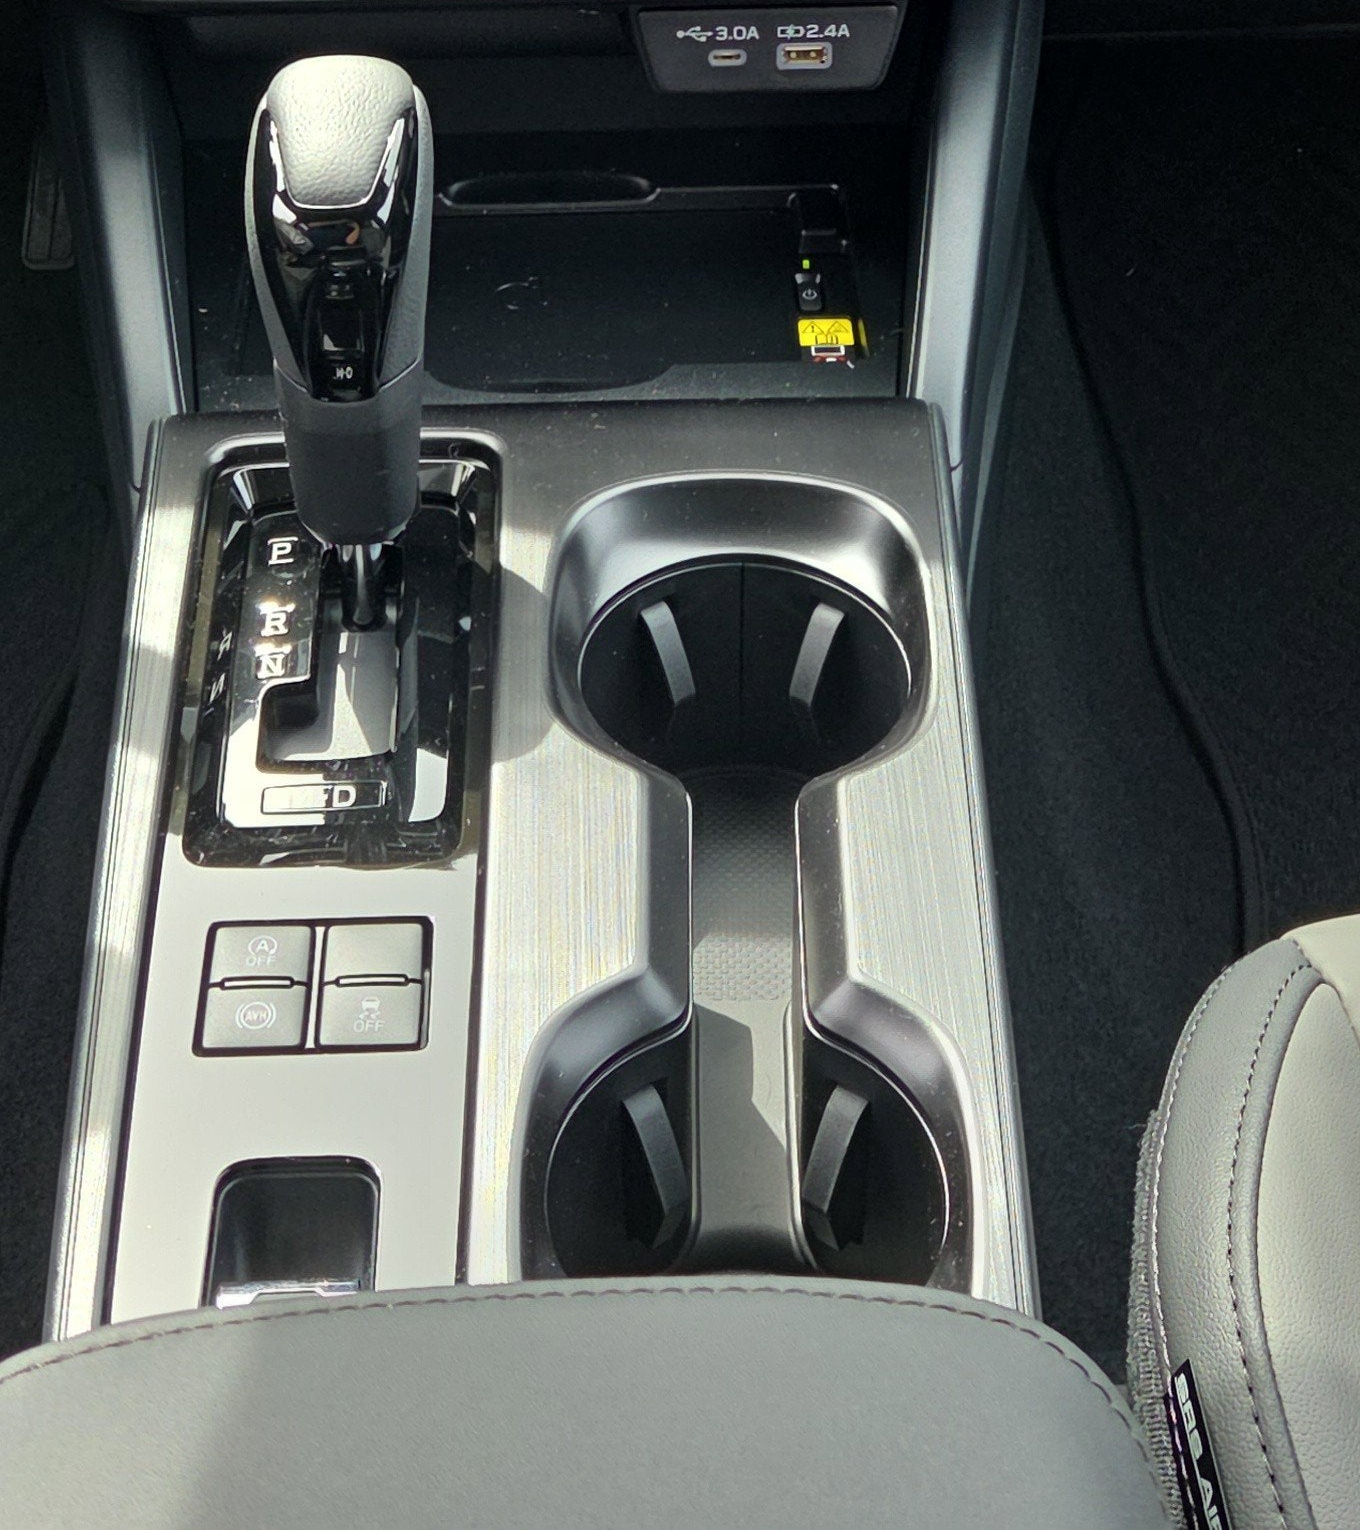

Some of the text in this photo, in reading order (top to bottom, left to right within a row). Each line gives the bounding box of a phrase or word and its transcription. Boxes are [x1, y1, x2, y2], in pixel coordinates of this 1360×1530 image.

[715, 26, 759, 40] 3.0A
[806, 24, 850, 38] 2.4A
[260, 610, 288, 636] R
[258, 654, 286, 678] N
[333, 785, 356, 808] D
[246, 957, 276, 966] OFF
[353, 1020, 385, 1031] OFF
